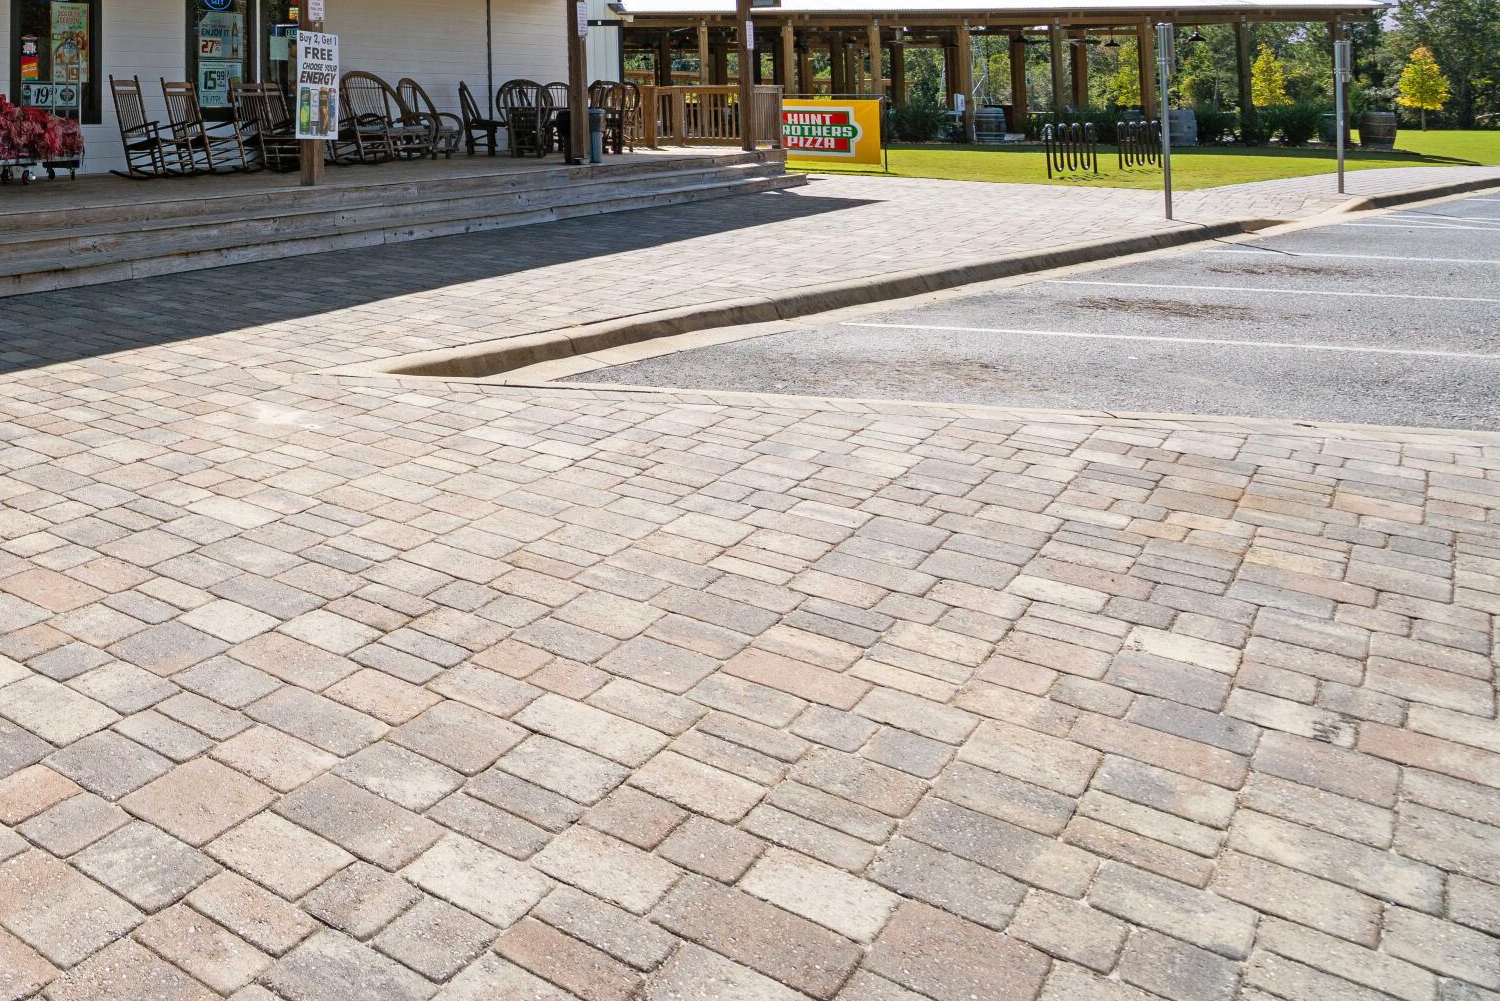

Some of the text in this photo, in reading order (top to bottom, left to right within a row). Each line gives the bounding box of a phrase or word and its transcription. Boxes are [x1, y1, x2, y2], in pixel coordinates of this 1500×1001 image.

[201, 28, 230, 37] ENJOY IT
[300, 33, 312, 46] Buy
[322, 36, 332, 45] Get
[304, 46, 333, 61] FREE
[303, 62, 338, 72] CHOOSE YOUR
[300, 71, 336, 85] ENERGY
[787, 113, 833, 125] HUNT
[782, 125, 853, 137] ROTHERS
[787, 136, 835, 148] PIZZA
